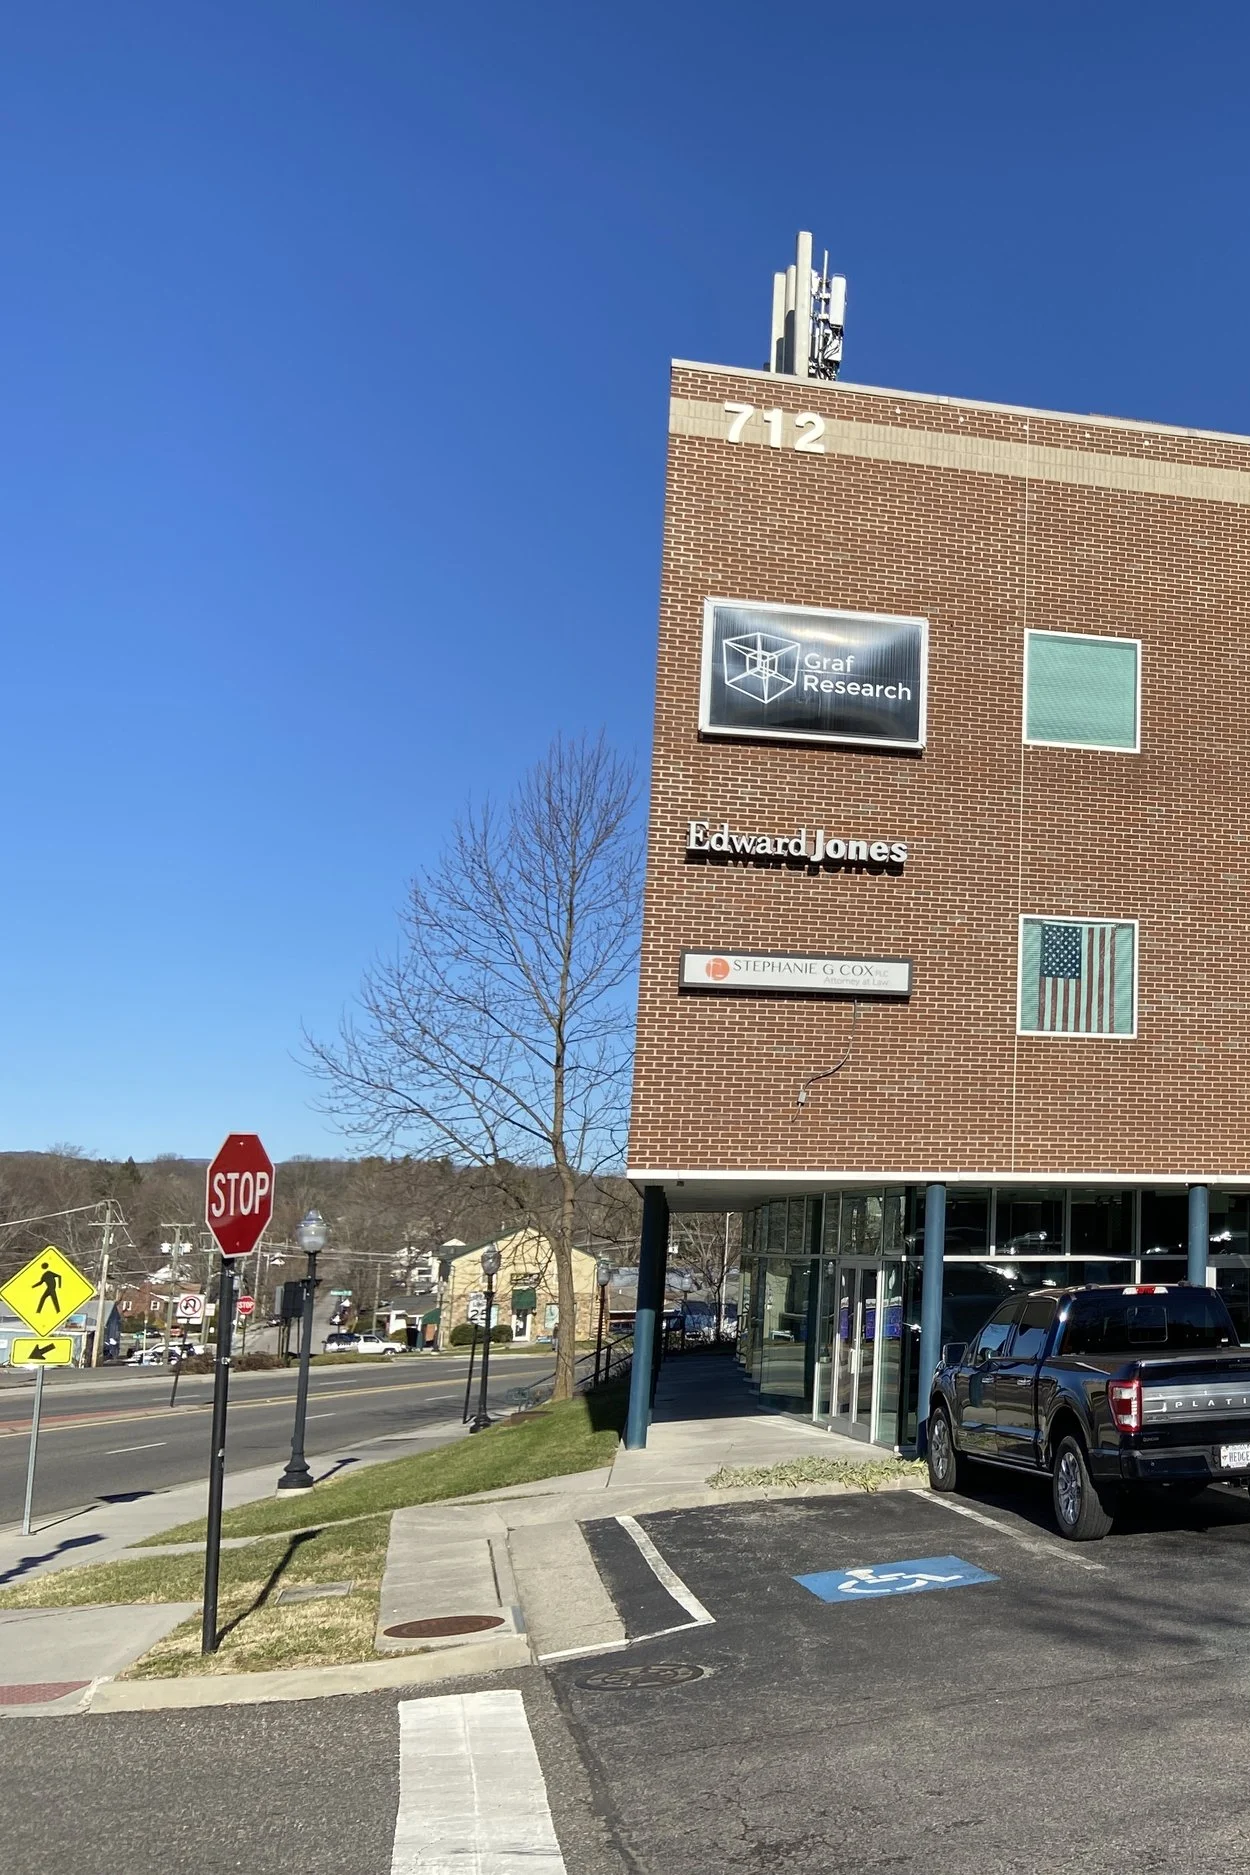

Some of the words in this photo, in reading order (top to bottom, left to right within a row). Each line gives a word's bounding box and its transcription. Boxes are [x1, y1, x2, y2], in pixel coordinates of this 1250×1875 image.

[724, 401, 825, 454] 712
[804, 652, 854, 673] Graf
[803, 674, 912, 701] Research
[733, 959, 817, 975] STEPHANIE
[822, 963, 834, 975] G
[839, 964, 874, 977] COX
[823, 975, 860, 987] Attorney
[872, 977, 889, 987] Law
[211, 1171, 270, 1217] STOP
[237, 1301, 254, 1309] STOP
